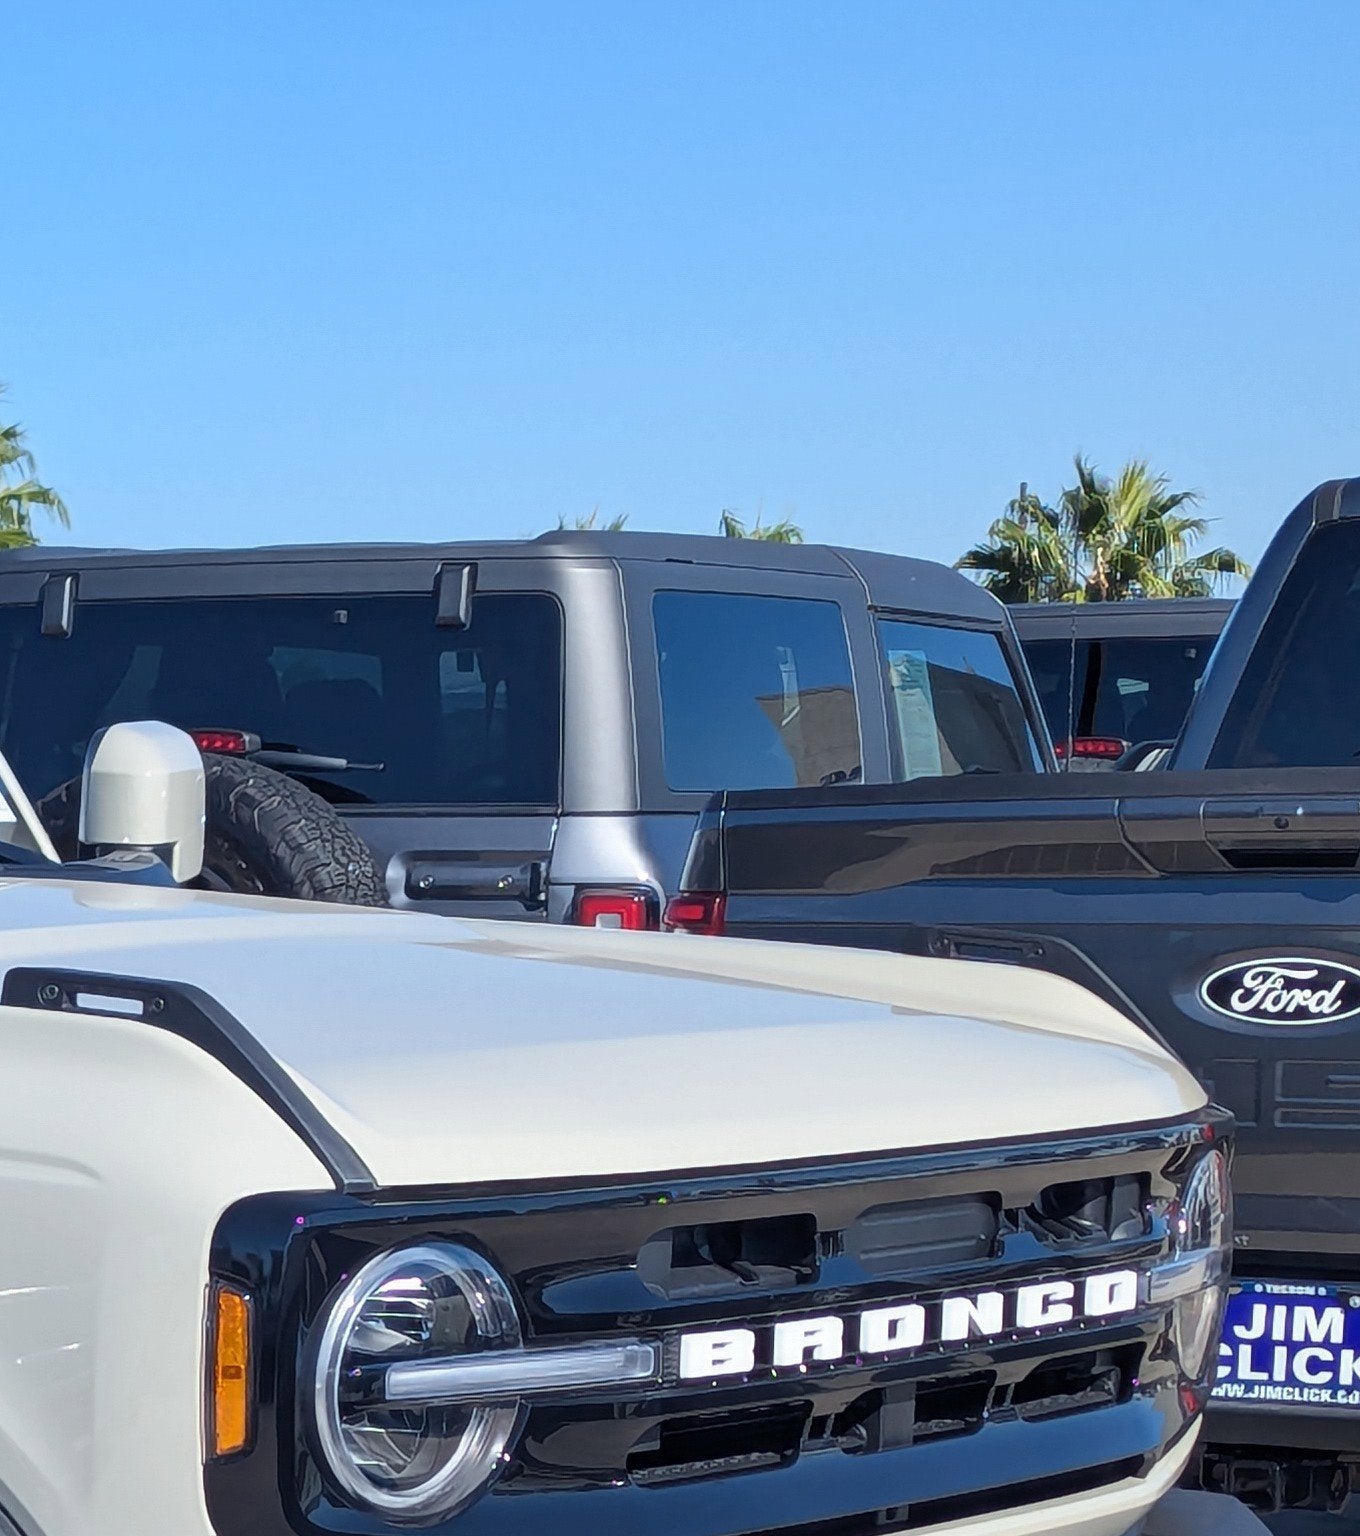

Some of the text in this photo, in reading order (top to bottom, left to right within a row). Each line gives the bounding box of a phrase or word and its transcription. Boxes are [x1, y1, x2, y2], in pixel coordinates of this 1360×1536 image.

[1230, 966, 1346, 1014] Ford
[680, 1269, 1138, 1379] BRONCO
[1233, 1303, 1345, 1343] JIM
